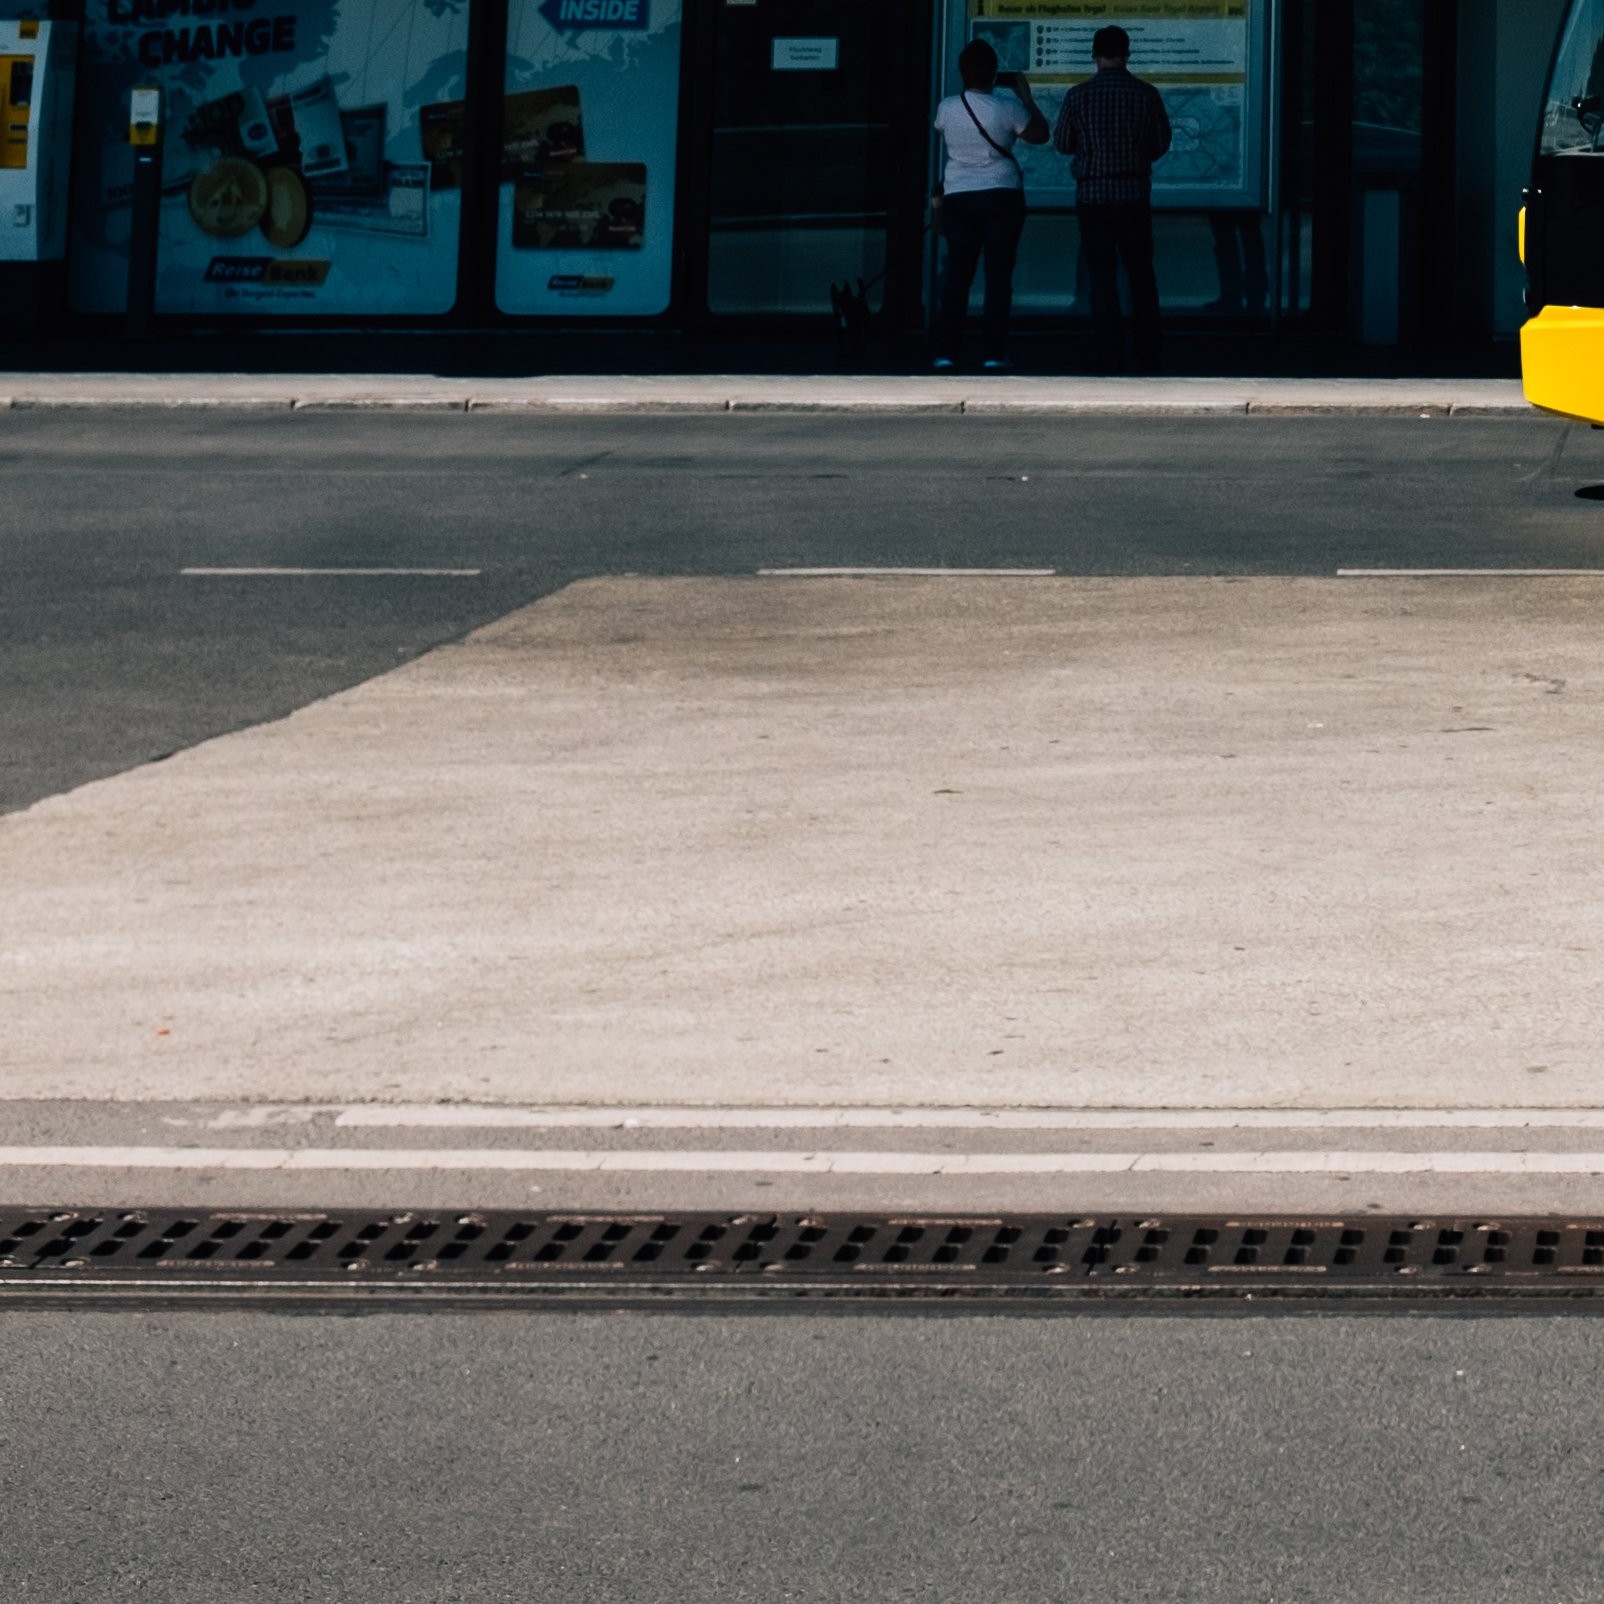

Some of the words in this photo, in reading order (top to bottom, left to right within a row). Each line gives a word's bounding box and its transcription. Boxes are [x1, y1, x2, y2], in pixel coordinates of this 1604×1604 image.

[560, 0, 641, 20] INSIDE
[140, 16, 296, 67] CHANGE
[211, 262, 263, 278] Reise
[271, 265, 318, 281] Bank
